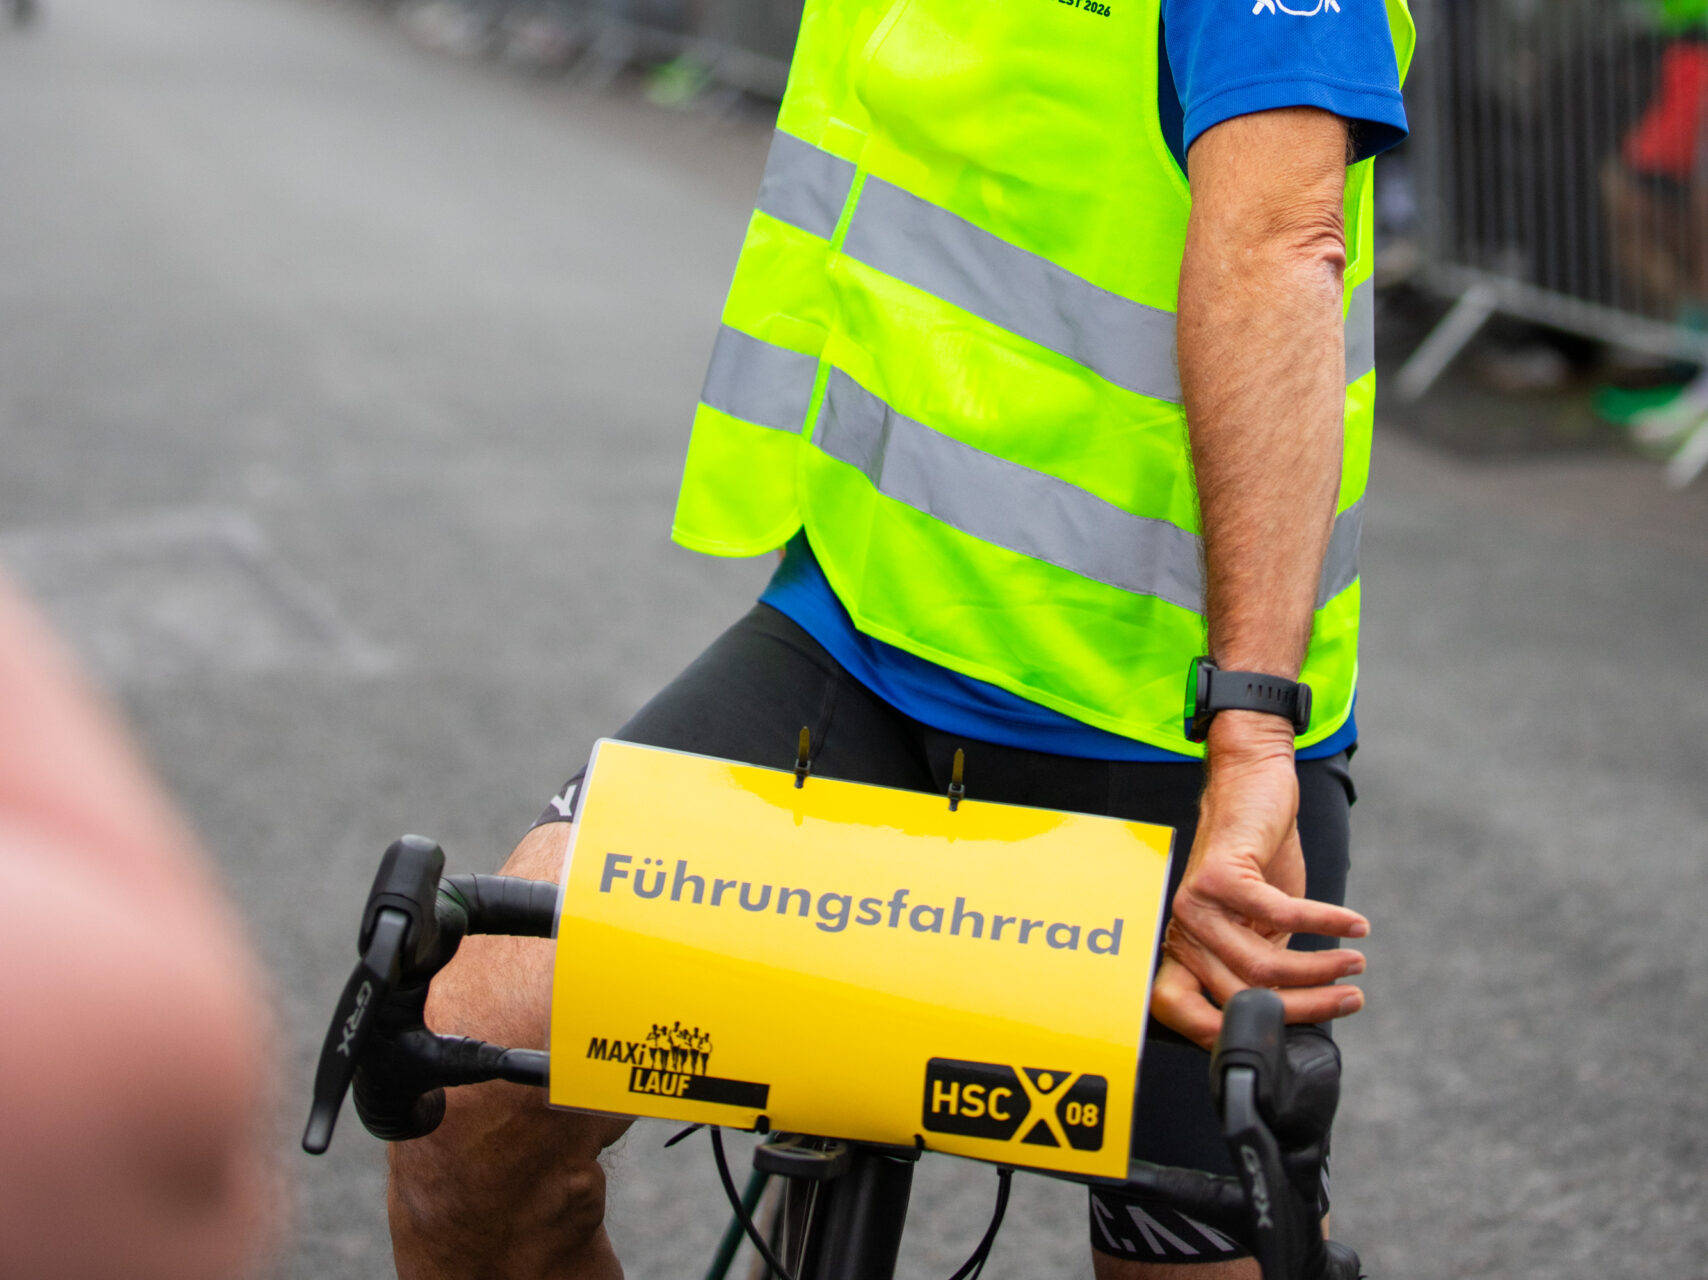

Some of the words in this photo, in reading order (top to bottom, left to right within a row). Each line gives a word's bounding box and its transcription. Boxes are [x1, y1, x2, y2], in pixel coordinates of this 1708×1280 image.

[1083, 0, 1111, 18] 2026
[599, 852, 1125, 957] Führungsfahrrad
[336, 980, 373, 1057] GRX
[632, 1068, 692, 1097] LAUF
[931, 1079, 1013, 1122] HSC
[1065, 1101, 1099, 1128] 08
